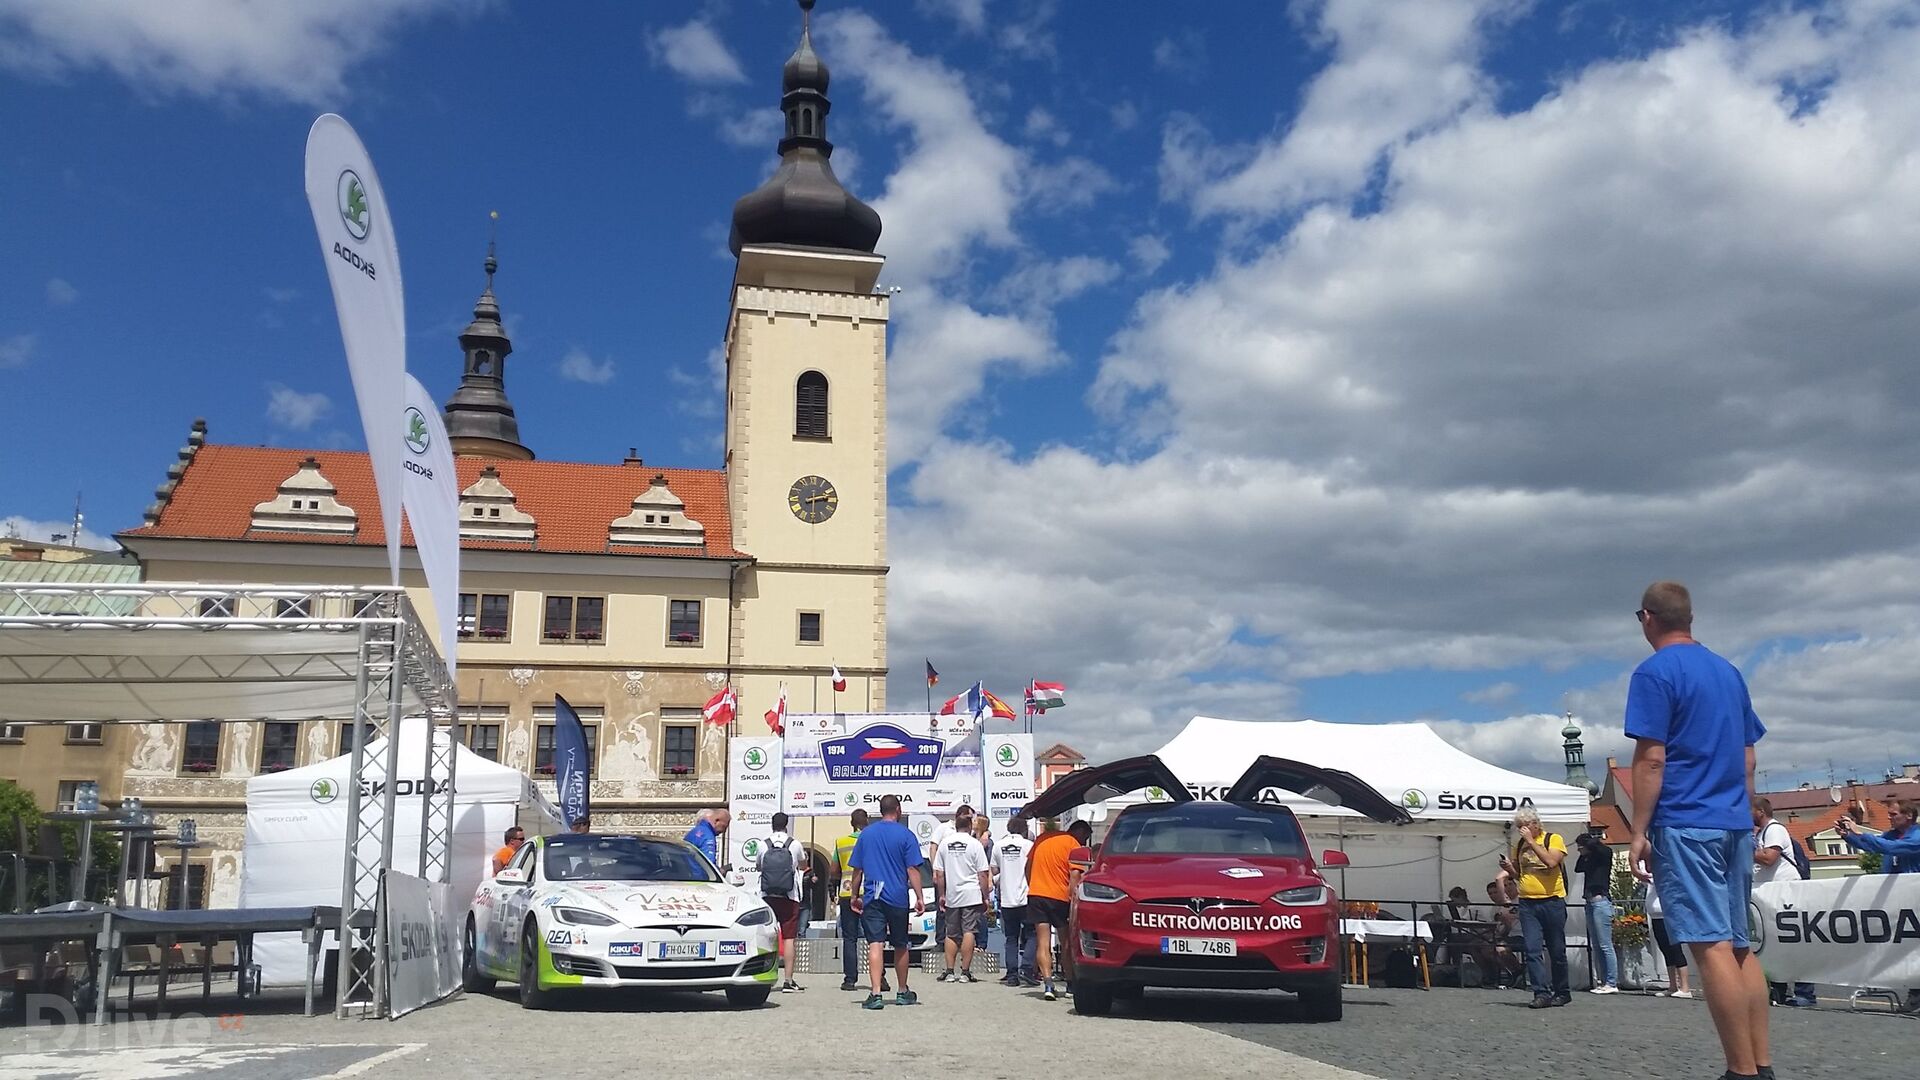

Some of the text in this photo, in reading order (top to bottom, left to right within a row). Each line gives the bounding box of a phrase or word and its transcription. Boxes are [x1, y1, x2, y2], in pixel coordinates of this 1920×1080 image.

[827, 745, 846, 755] 1974
[918, 744, 938, 754] 2018
[740, 772, 770, 780] ŠKODA
[832, 764, 933, 778] RALLY BOHEMIA
[863, 792, 913, 803] ŠKDA
[991, 791, 1029, 800] MOGUL
[1438, 790, 1534, 811] ŠKODA
[1131, 911, 1302, 931] ELEKTROMOBILY.ORG
[1775, 903, 1920, 944] ŠKODA
[545, 930, 573, 944] REA
[610, 945, 631, 953] KIKU
[720, 944, 738, 952] KIKU
[1172, 939, 1193, 953] 1BL
[1201, 941, 1231, 954] 7486
